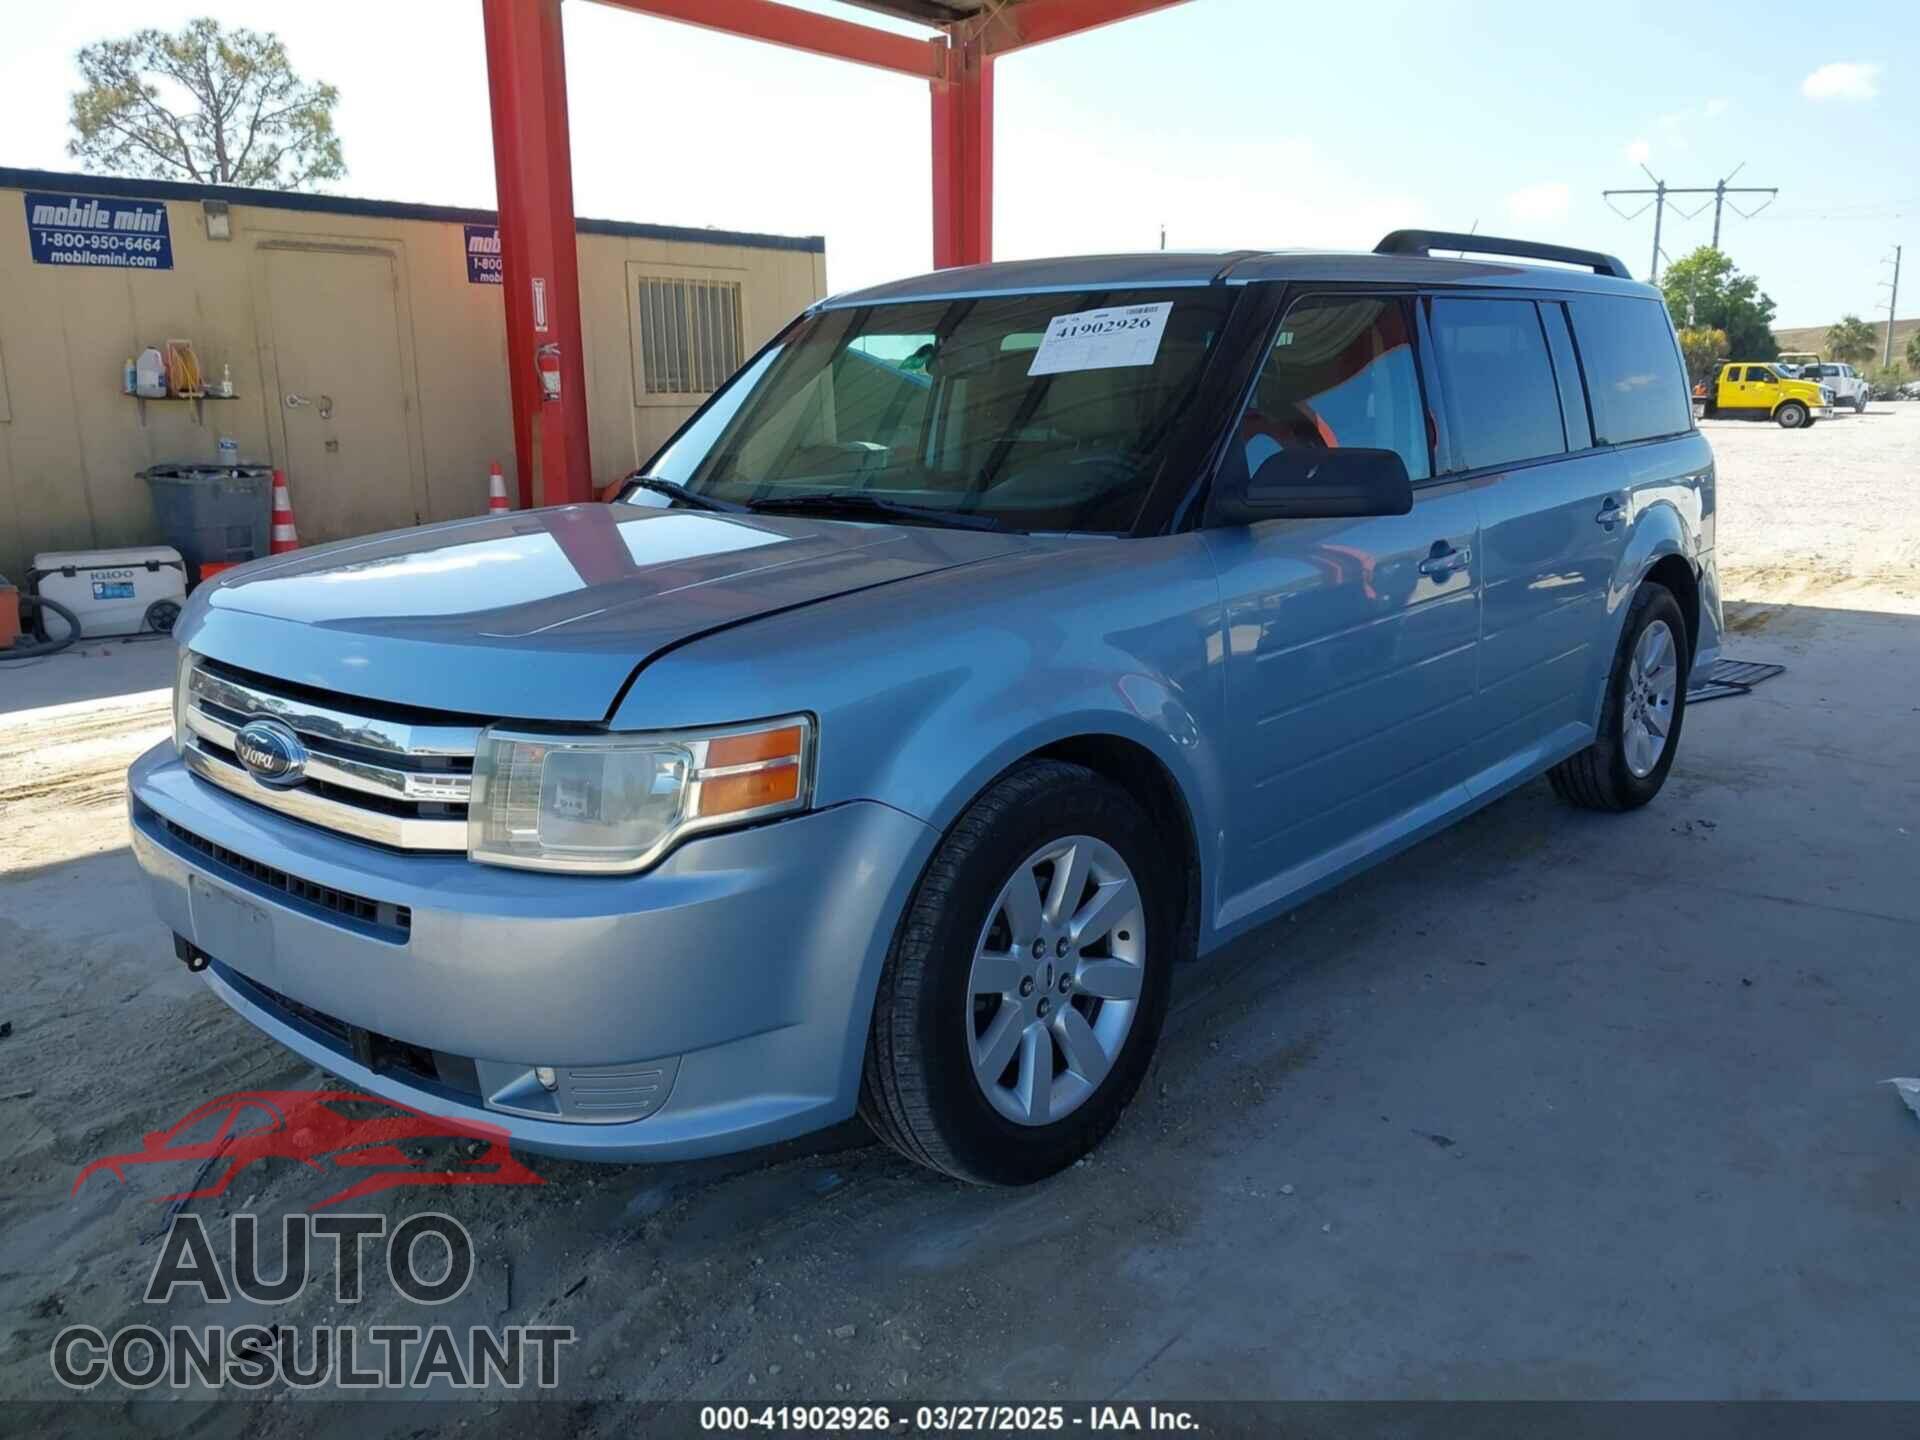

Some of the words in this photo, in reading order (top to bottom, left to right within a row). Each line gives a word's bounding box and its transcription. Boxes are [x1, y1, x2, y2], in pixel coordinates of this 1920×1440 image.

[32, 198, 111, 229] mobile
[113, 207, 164, 232] mini
[40, 231, 161, 252] 1-800-950-6464
[50, 250, 158, 267] mobilemini.com
[1056, 317, 1151, 338] 41902926
[241, 733, 274, 769] Ford
